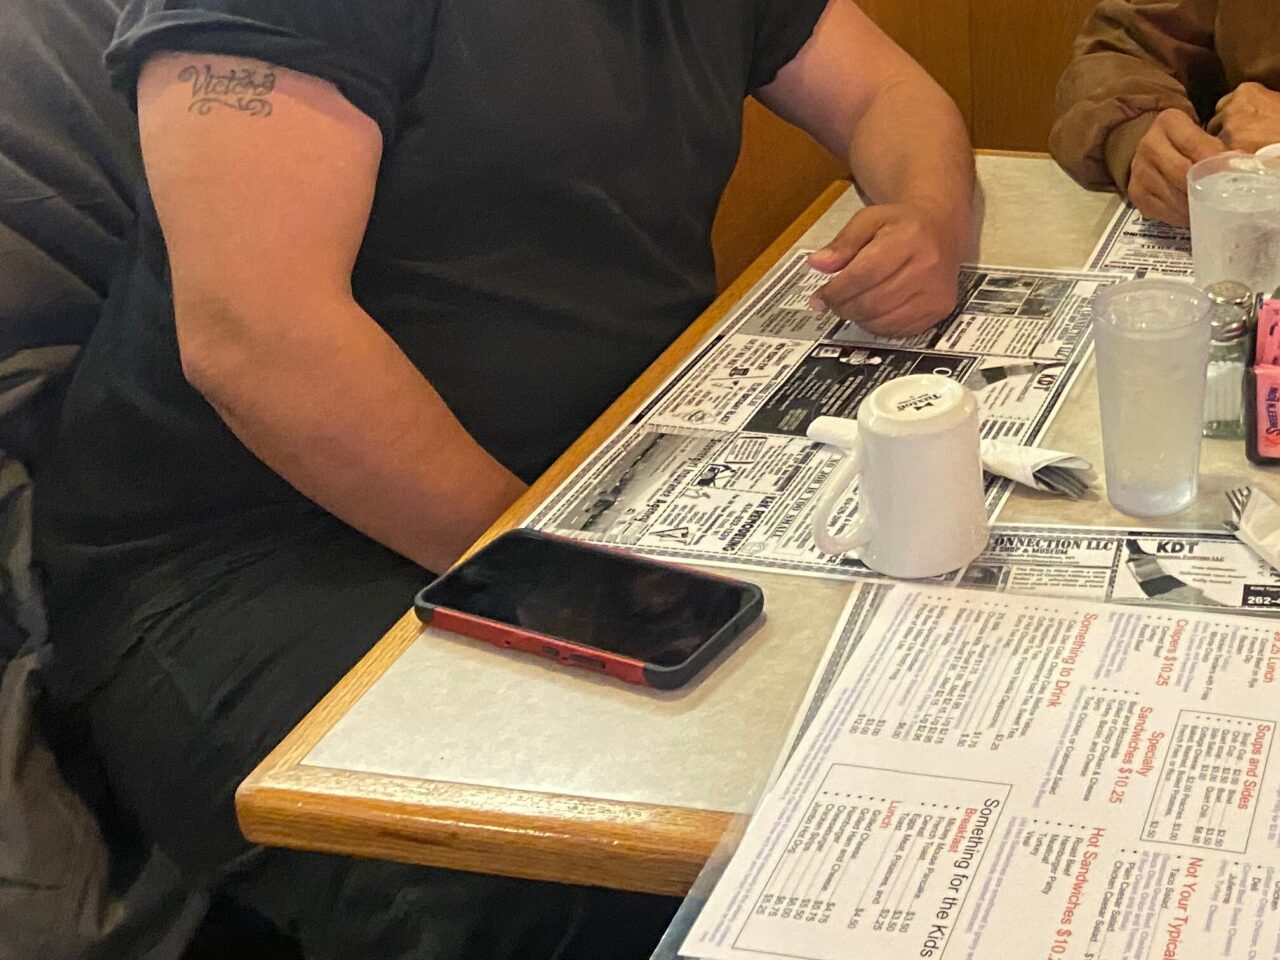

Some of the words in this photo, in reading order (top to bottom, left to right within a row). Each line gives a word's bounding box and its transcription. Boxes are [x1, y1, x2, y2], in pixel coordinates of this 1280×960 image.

[1032, 373, 1057, 391] KDT
[812, 470, 829, 484] JOB
[632, 498, 668, 523] Agency
[790, 496, 809, 511] TOO
[720, 509, 765, 552] REMODELING
[768, 513, 796, 540] SMALL
[990, 536, 1084, 551] ONNECTION
[1085, 540, 1114, 551] LLC
[1031, 547, 1069, 555] MUSEUM
[1156, 541, 1199, 554] KDT
[1060, 612, 1098, 665] Something
[1164, 618, 1189, 654] Crispers
[1058, 666, 1075, 677] to
[1154, 654, 1177, 687] $10.25
[1262, 656, 1280, 684] Lunch
[1045, 679, 1070, 708] Drink
[1120, 705, 1153, 765] Sandwiches
[1247, 722, 1271, 755] Soups
[1134, 730, 1165, 777] Specialty
[1244, 757, 1262, 777] and
[1107, 766, 1133, 804] $10.25
[1236, 778, 1257, 811] Sides
[812, 802, 834, 831] Chicken
[830, 805, 857, 844] Hamburger
[877, 799, 903, 829] Lunch
[914, 813, 933, 837] Cereal
[795, 825, 810, 838] Hot
[842, 830, 858, 847] Ham
[946, 807, 978, 854] Breakfast
[952, 797, 1000, 869] Something
[1021, 830, 1035, 847] Veal
[1085, 826, 1106, 849] Hot
[1213, 828, 1226, 847] $2.50
[786, 838, 803, 854] Dog
[834, 848, 849, 862] and
[849, 832, 870, 859] Cheese
[916, 840, 933, 861] Toast
[926, 841, 945, 866] Mouse
[1028, 831, 1047, 857] Turkey
[819, 862, 842, 891] Cheese
[1061, 858, 1076, 876] Beef
[1105, 859, 1123, 890] Chicken
[1165, 867, 1179, 886] Taco
[1184, 856, 1203, 878] Not
[946, 872, 969, 893] for
[1039, 874, 1057, 895] Patty
[1058, 849, 1098, 926] Sandwiches
[1248, 876, 1261, 892] Deli
[752, 892, 774, 916] $5.25
[765, 894, 786, 917] $6.75
[870, 889, 886, 905] and
[1096, 890, 1113, 918] Caesar
[1159, 886, 1174, 909] Salad
[1174, 880, 1196, 912] Your
[790, 897, 810, 920] $5.50
[803, 899, 823, 922] $5.75
[816, 900, 836, 924] $4.75
[846, 906, 864, 929] $4.50
[871, 907, 890, 931] $2.25
[884, 909, 902, 932] $3.50
[934, 896, 959, 921] the
[897, 910, 915, 933] $3.50
[1088, 919, 1105, 943] Salad
[1105, 909, 1121, 933] Salad
[917, 923, 948, 959] Kids
[1045, 927, 1072, 960] $10.
